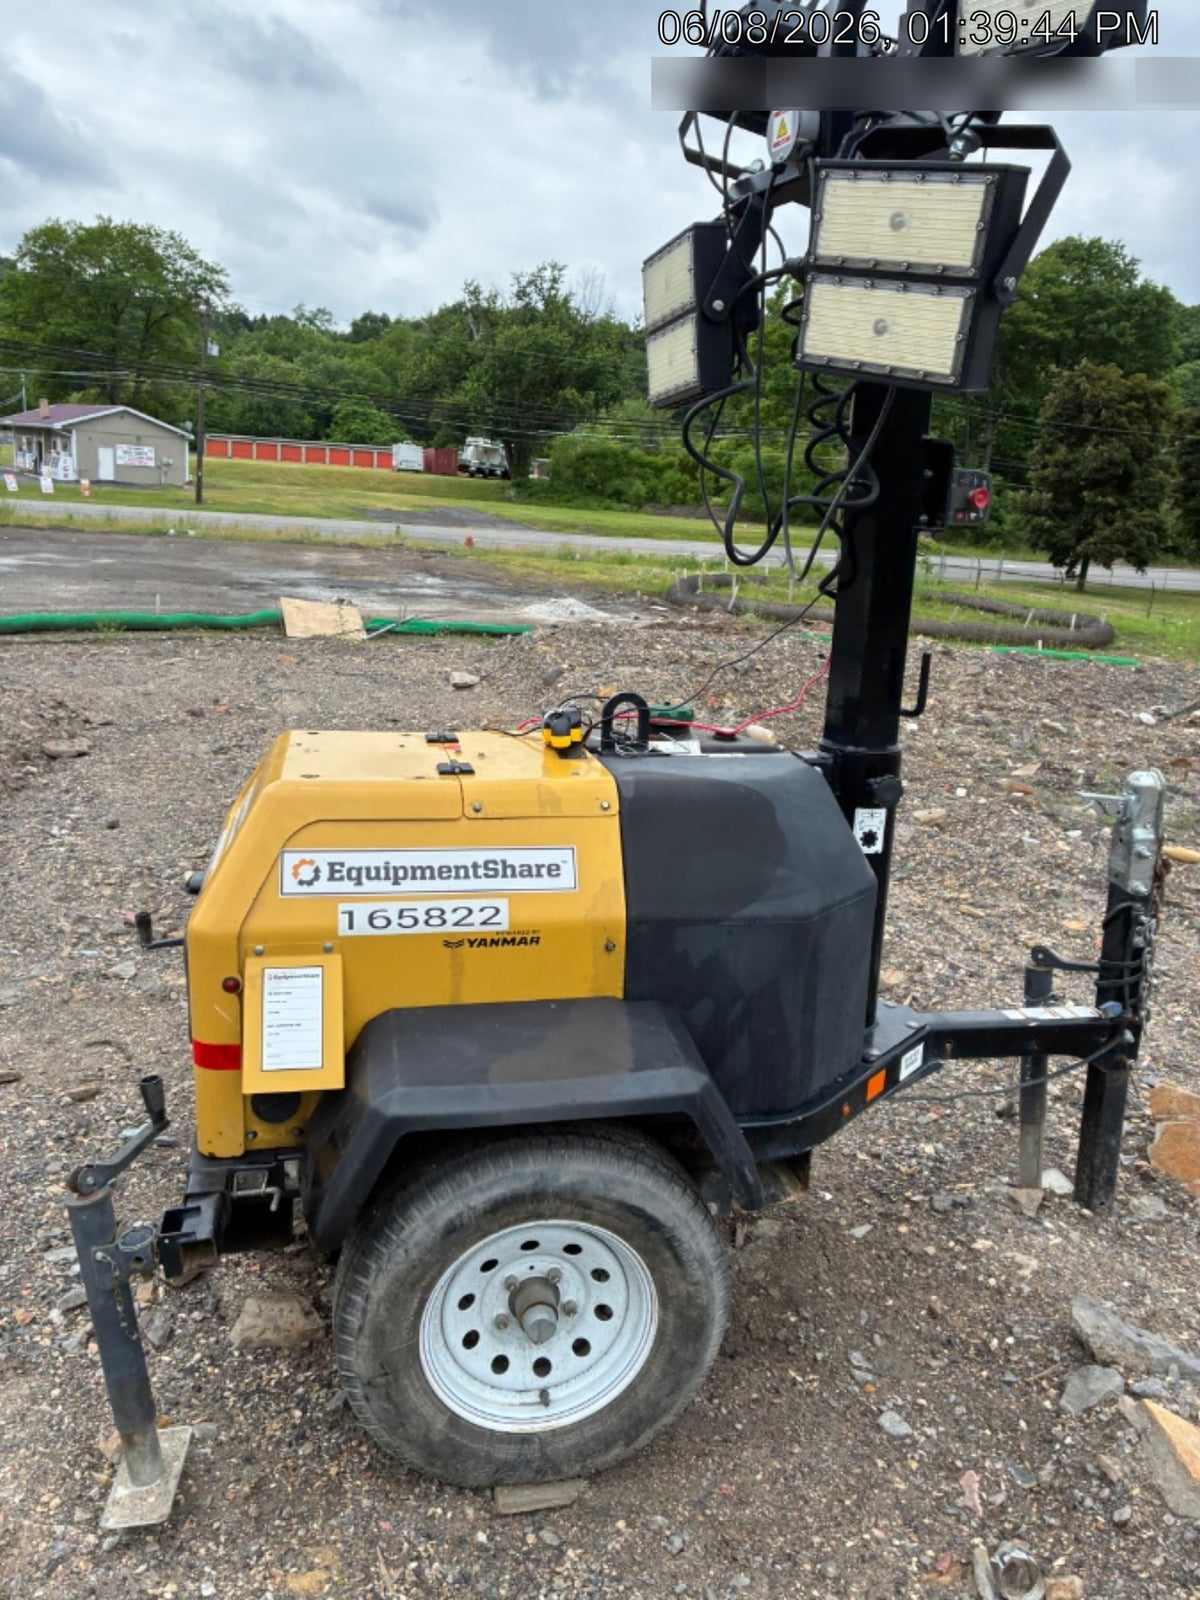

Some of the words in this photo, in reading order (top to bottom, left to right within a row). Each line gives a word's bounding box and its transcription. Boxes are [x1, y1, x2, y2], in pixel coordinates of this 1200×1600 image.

[326, 859, 563, 887] EquipmentShare
[341, 906, 503, 931] 165822
[466, 936, 541, 949] YANMAR
